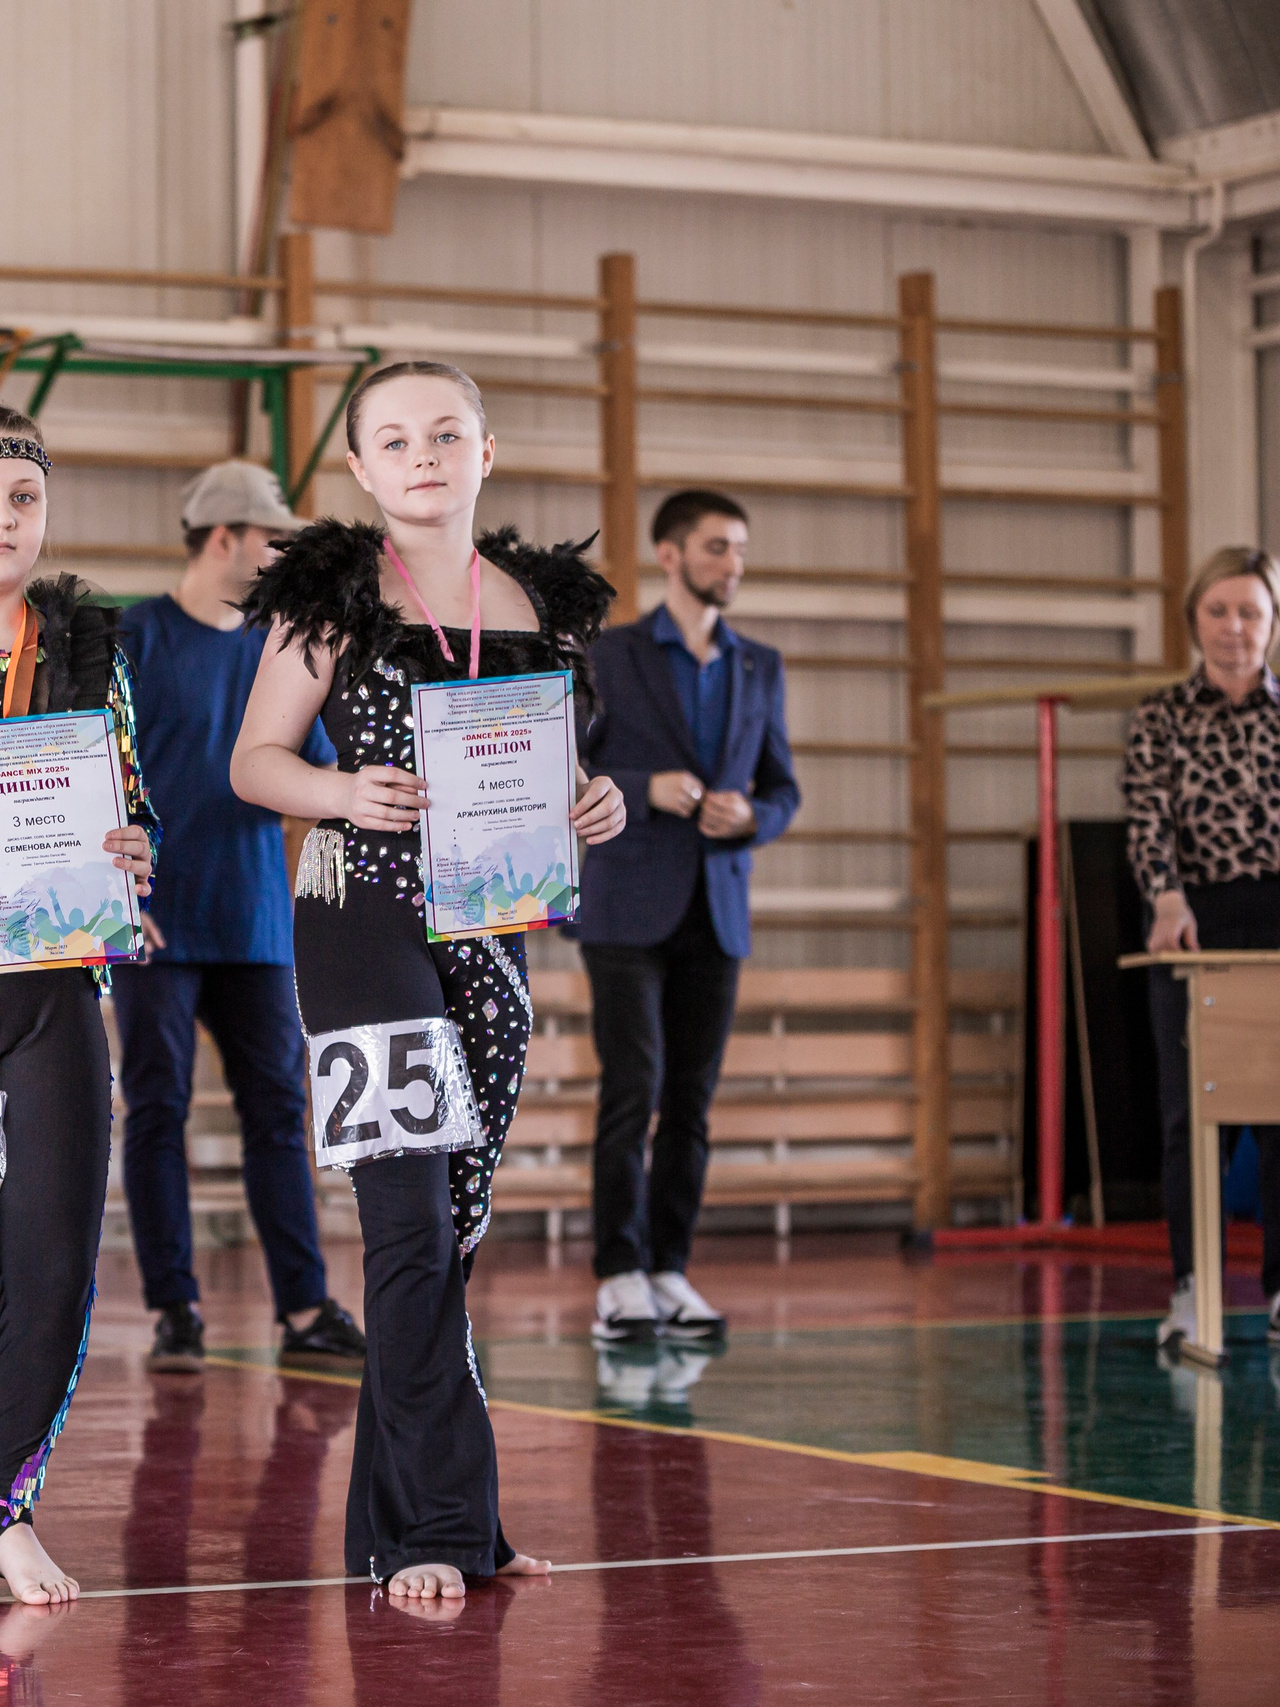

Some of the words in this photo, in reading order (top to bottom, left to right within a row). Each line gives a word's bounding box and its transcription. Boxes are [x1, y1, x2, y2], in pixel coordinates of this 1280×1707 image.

[462, 733, 492, 741] «DANCE
[511, 728, 531, 736] 2025»
[463, 740, 531, 759] ДИПЛОМ
[481, 759, 517, 768] награждается
[478, 780, 485, 791] 4
[490, 778, 524, 790] место
[13, 796, 55, 804] награждается
[457, 807, 507, 818] АРЖАНУХИНА
[510, 803, 546, 813] ВИКТОРИЯ
[12, 816, 21, 827] 3
[25, 814, 65, 825] место
[4, 843, 51, 852] СЕМЕНОВА
[53, 840, 81, 848] АРИНА
[317, 1030, 449, 1148] 25
